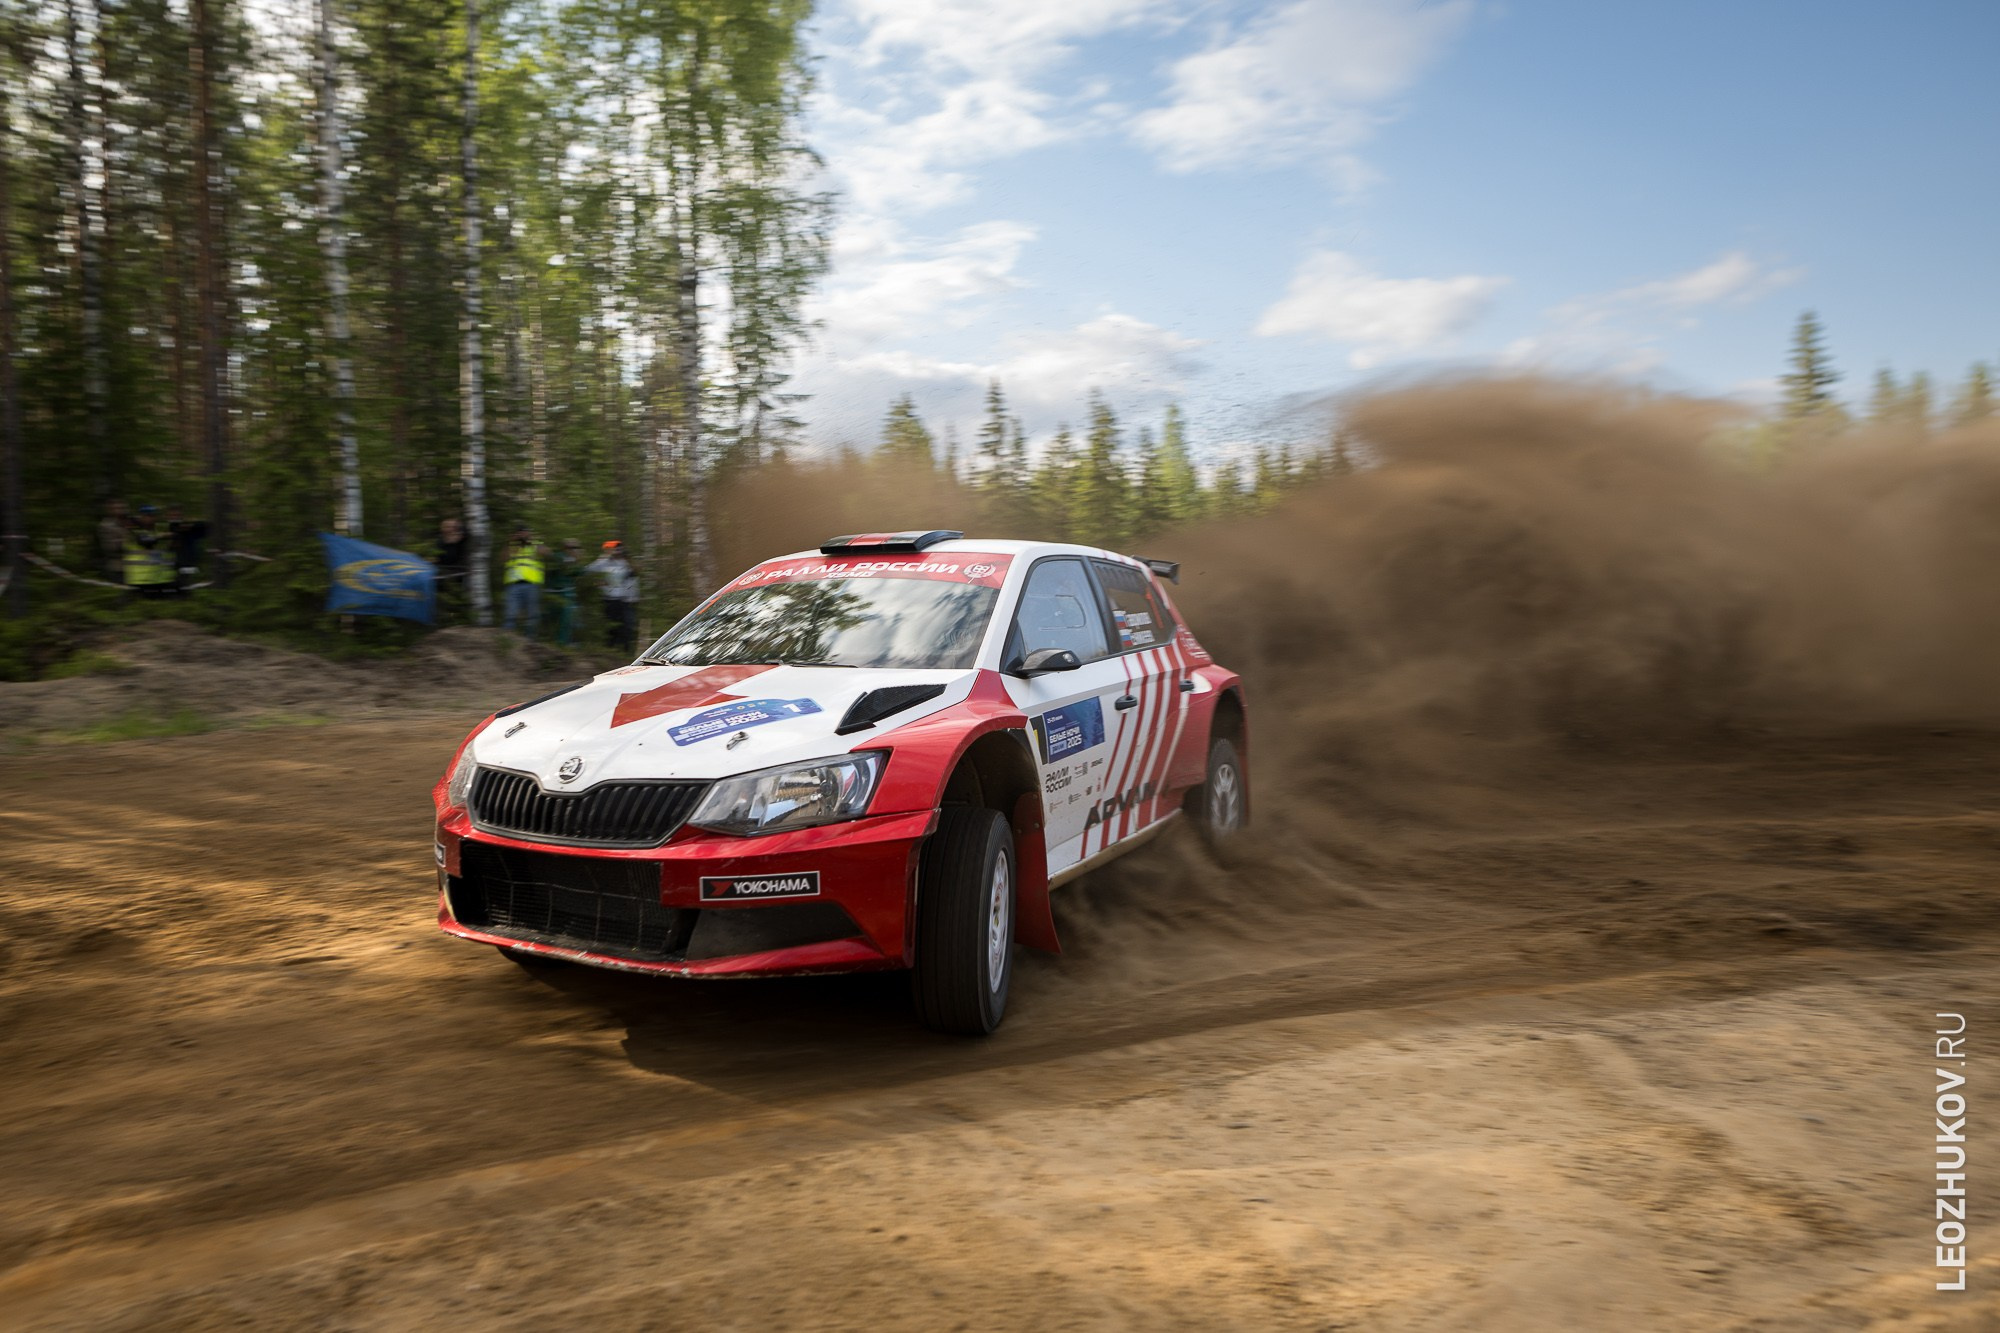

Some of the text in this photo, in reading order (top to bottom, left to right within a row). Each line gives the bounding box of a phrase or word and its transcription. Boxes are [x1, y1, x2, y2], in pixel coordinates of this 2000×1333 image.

[764, 561, 959, 580] РАЛЛИ РОССИИ
[782, 704, 802, 713] 1
[1049, 730, 1067, 744] БЕЛЫЕ
[1066, 726, 1080, 738] НОЧИ
[1067, 734, 1082, 748] 2025
[1045, 766, 1069, 784] РАЛЛИ
[1045, 776, 1072, 793] РОССИИ
[733, 878, 811, 894] YOKOHAMA
